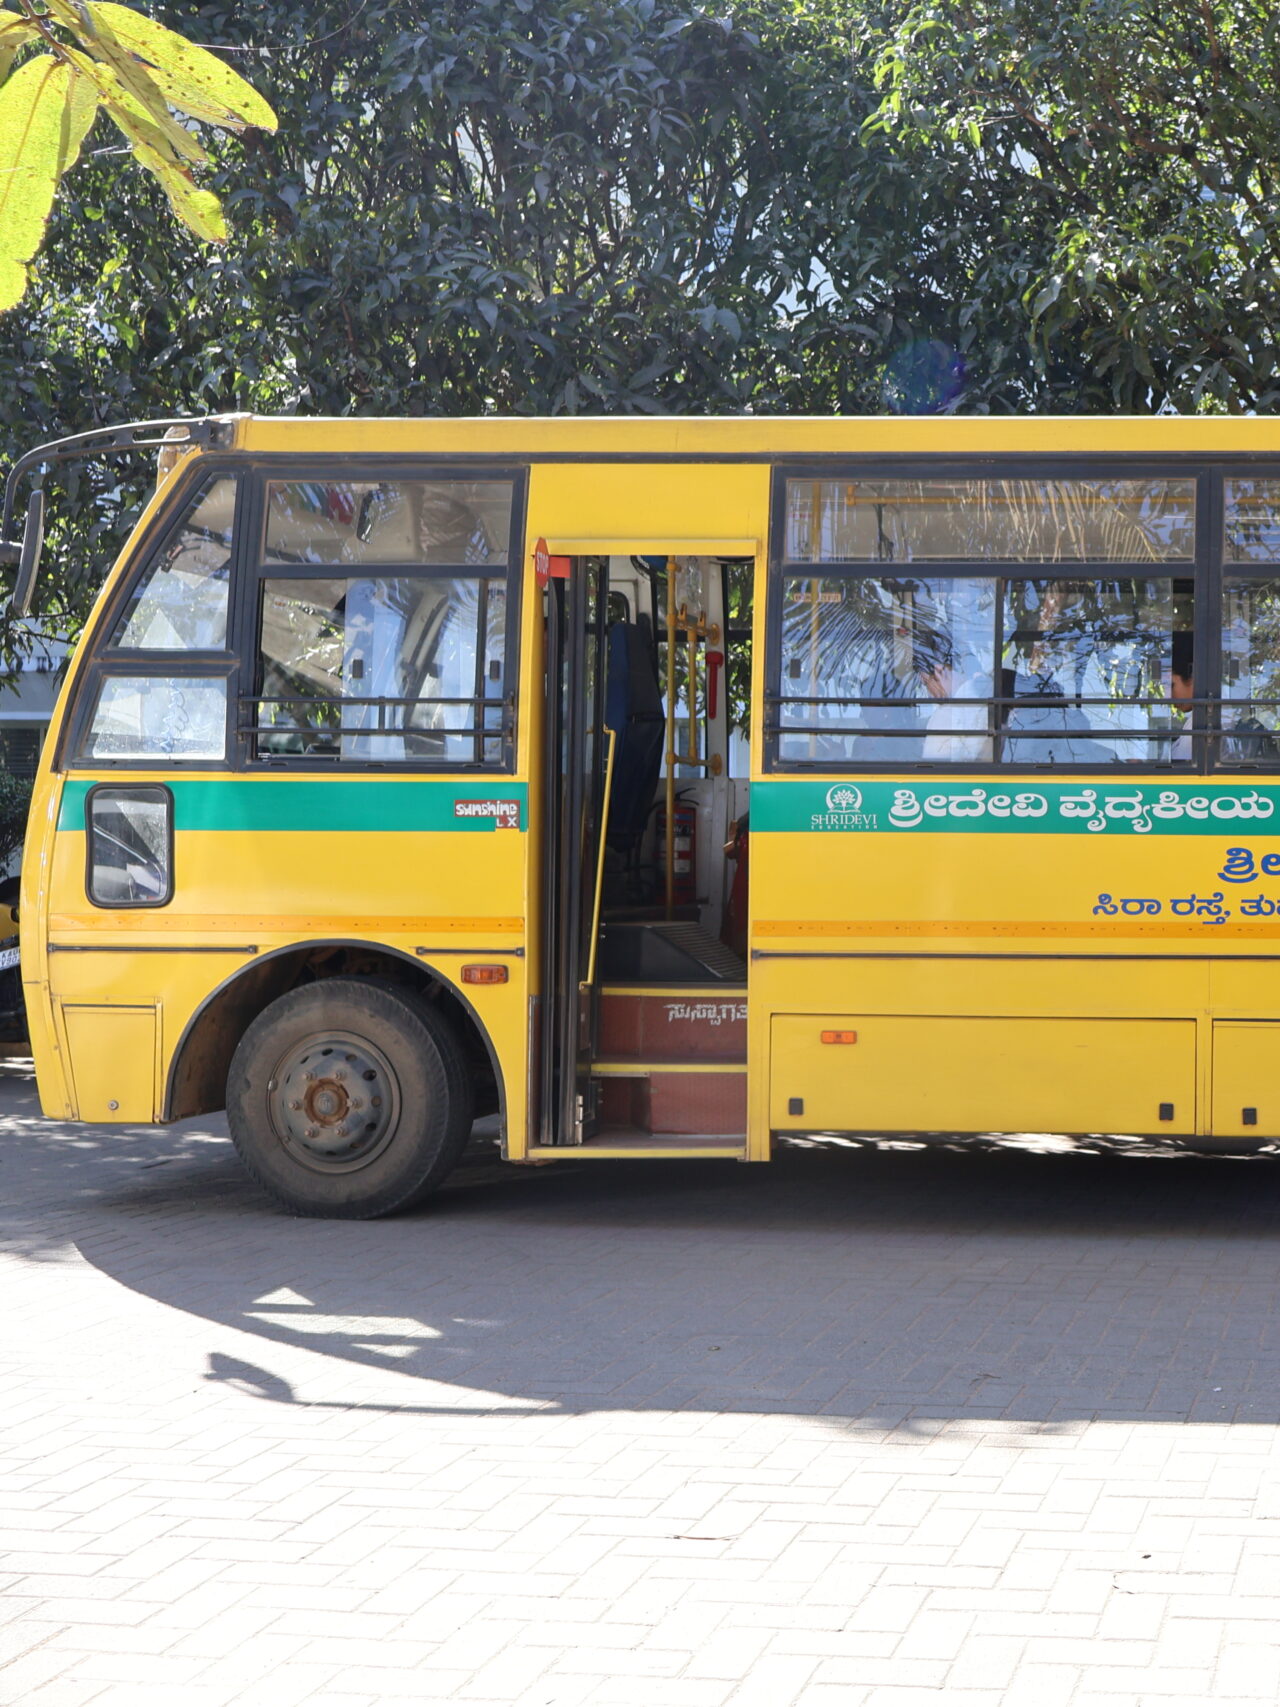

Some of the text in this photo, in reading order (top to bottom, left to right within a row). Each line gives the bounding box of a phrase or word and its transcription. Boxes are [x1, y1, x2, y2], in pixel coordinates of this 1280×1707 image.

[455, 800, 517, 816] sunshine
[889, 788, 1048, 828] ಶ್ರೀದೇವಿ
[1059, 789, 1273, 833] ವೈದ್ಯಕೀಯ
[811, 814, 877, 825] SHRIDEVI
[1092, 893, 1162, 916] ಸಿರಾ
